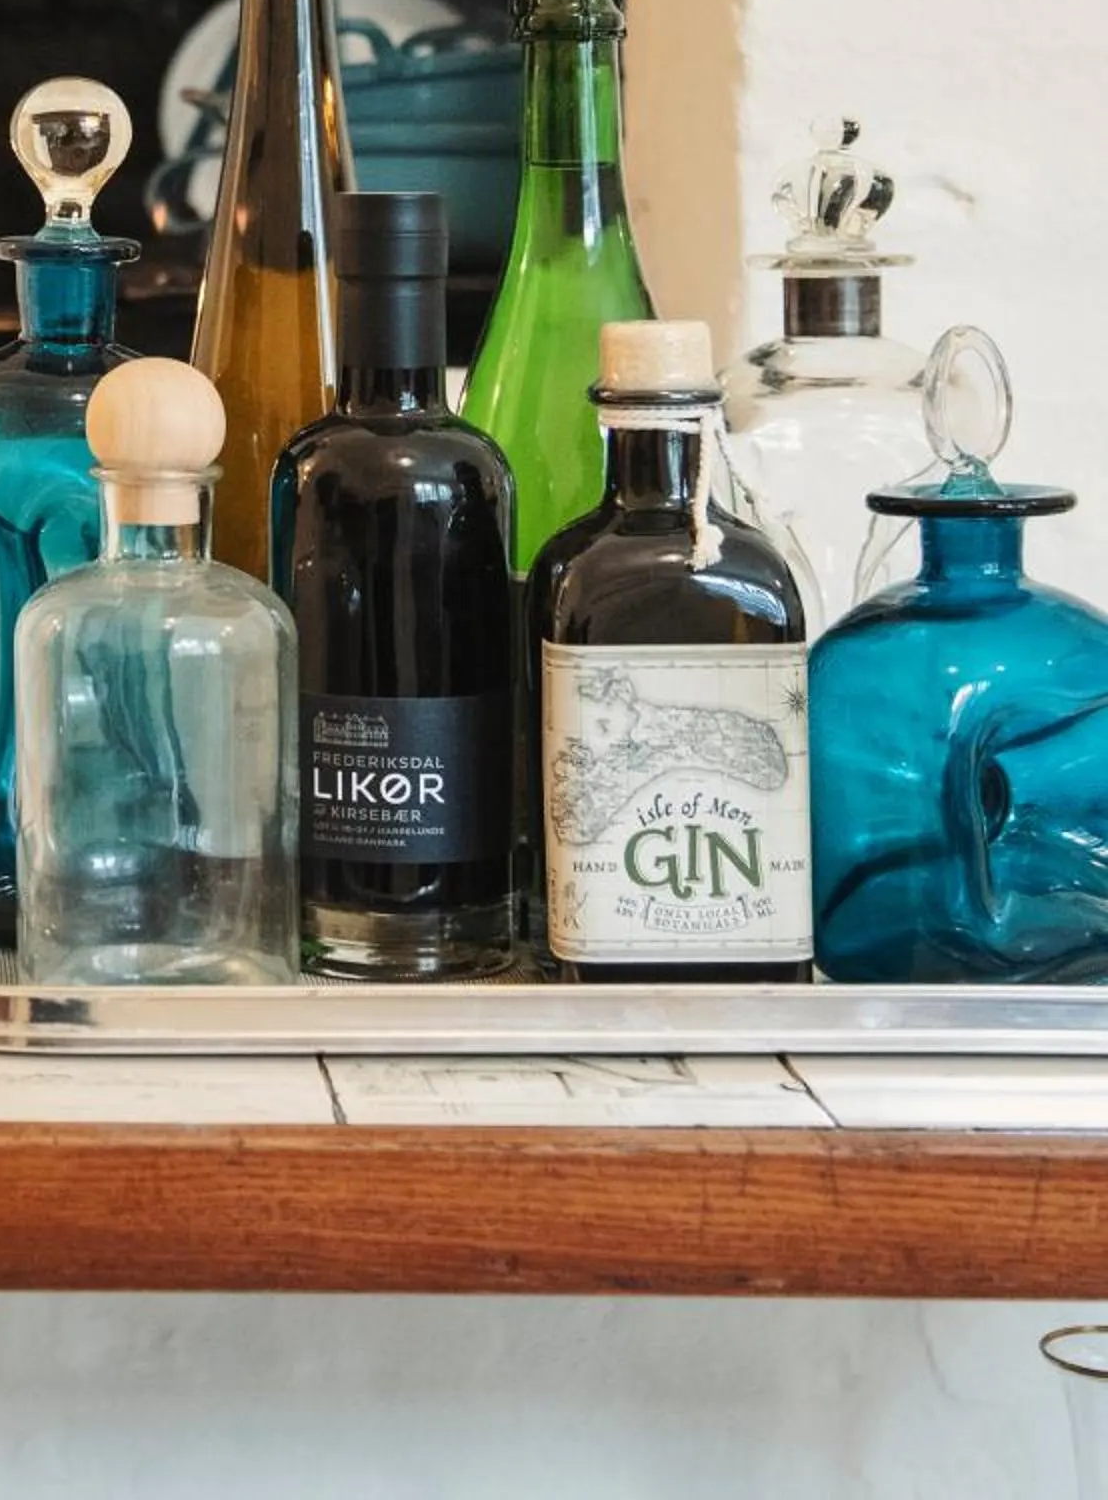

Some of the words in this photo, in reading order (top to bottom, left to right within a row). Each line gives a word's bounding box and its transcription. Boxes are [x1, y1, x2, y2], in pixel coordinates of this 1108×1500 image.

[313, 751, 445, 769] FREDERIKSDAL
[313, 767, 445, 804] LIKØR
[331, 805, 422, 822] KIRSEBÆR
[682, 792, 703, 818] of
[572, 860, 618, 873] HAND
[624, 823, 761, 898] GIN
